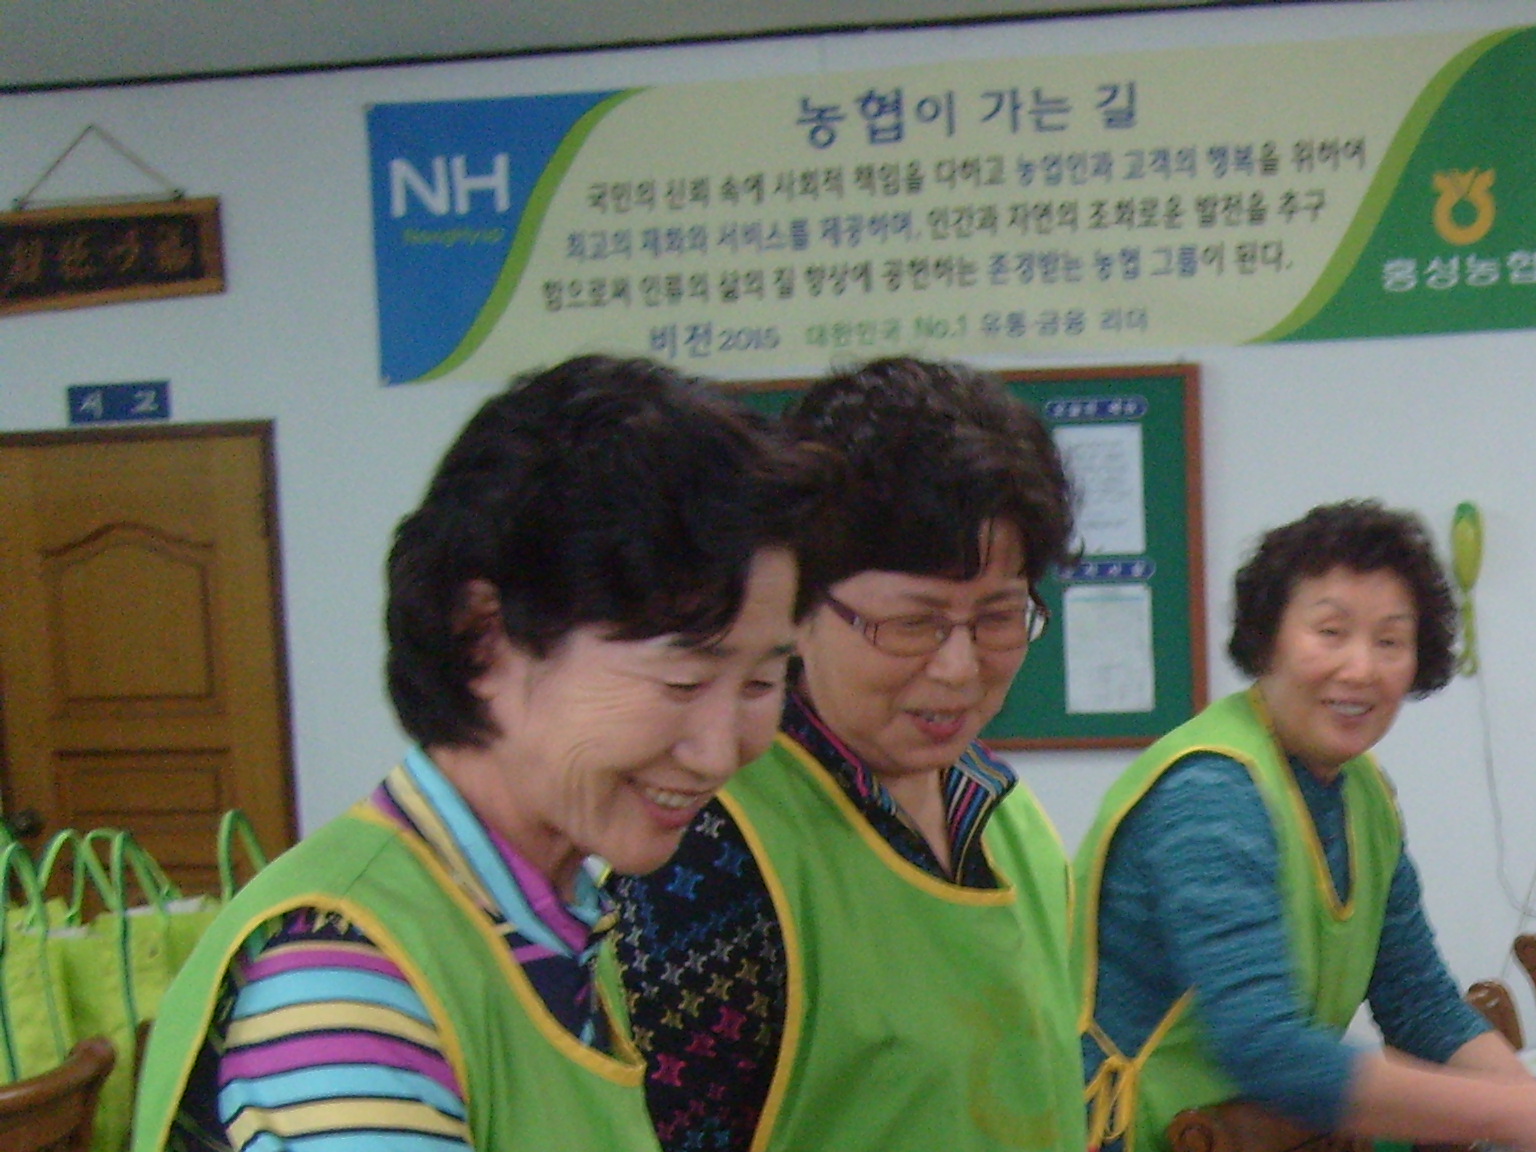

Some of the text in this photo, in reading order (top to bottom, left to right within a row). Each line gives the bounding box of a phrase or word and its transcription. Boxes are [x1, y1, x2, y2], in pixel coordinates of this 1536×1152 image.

[795, 81, 1137, 149] 농협이 가는 길
[390, 153, 510, 218] NH
[588, 136, 1366, 214] 국민의 신뢰 속에 사회적 책임을 다하고 농업인과 고객의 행복을 위하여
[567, 228, 632, 262] 최고의
[717, 218, 809, 253] 서비스를
[927, 203, 998, 240] 인간과
[1007, 201, 1079, 236] 자연의
[1087, 195, 1184, 231] 조화로운
[1196, 191, 1268, 228] 발전을
[1277, 188, 1326, 223] 추구
[542, 239, 1293, 312] 함으로써 인류의 삶의 질 향상에 공헌하는 존경받는 농협 그룹이 된다.
